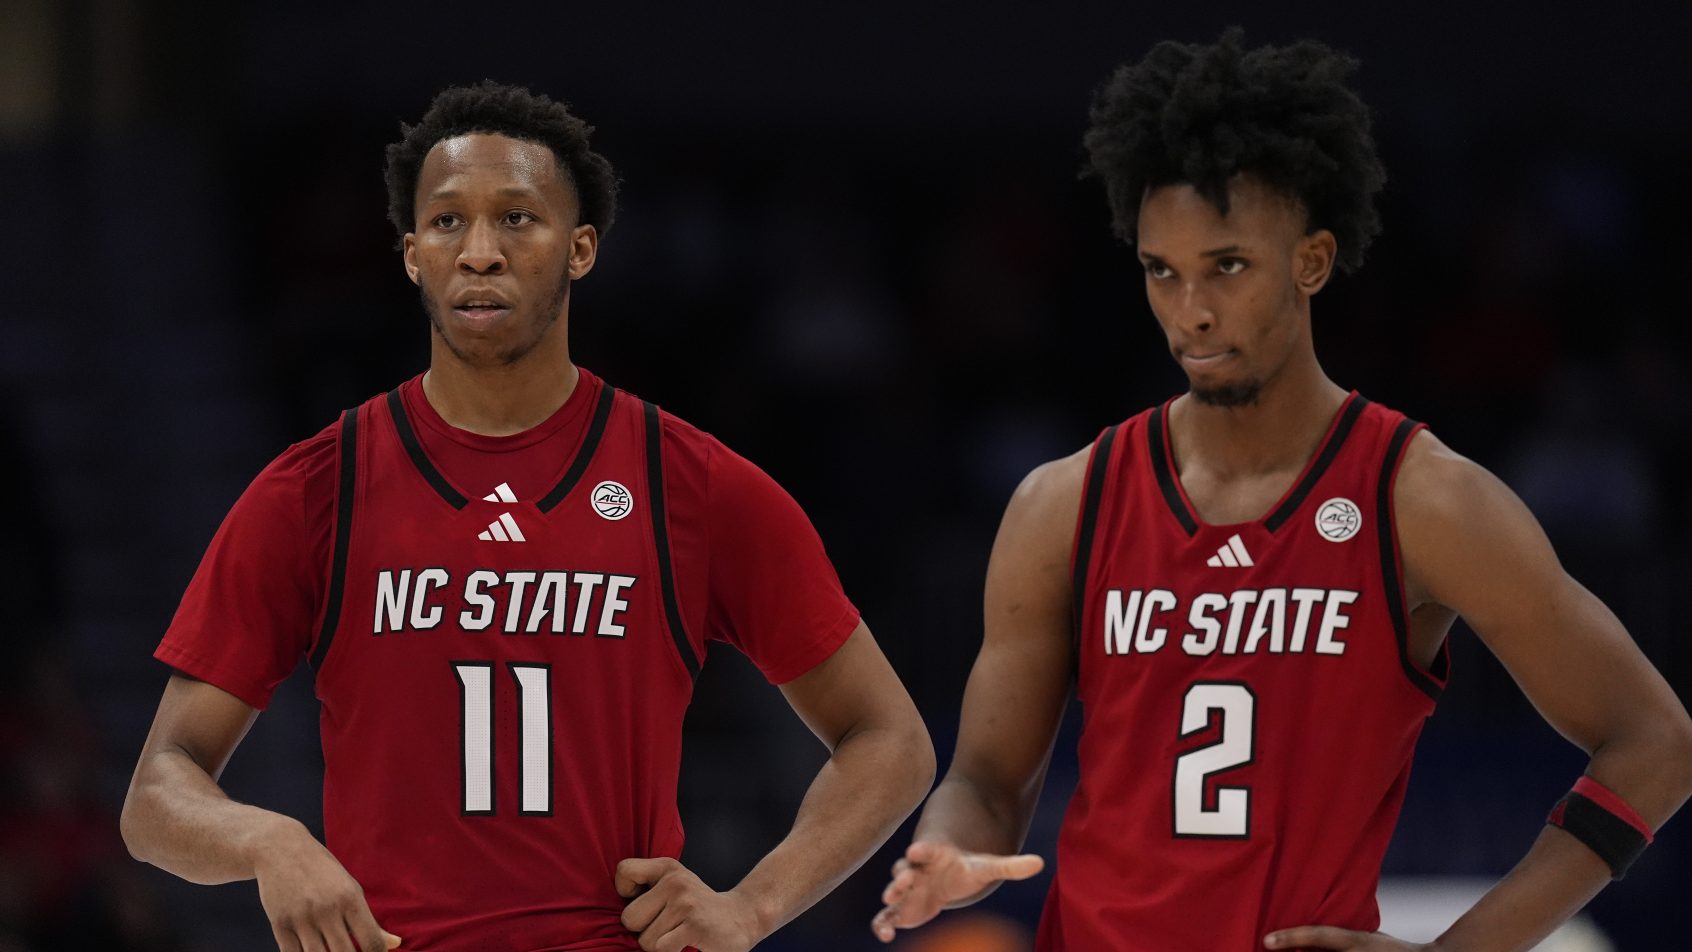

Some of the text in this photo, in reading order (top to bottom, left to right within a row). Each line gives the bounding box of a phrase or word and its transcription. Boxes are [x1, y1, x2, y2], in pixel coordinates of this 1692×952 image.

[598, 494, 628, 503] ACC
[1325, 513, 1355, 524] ACC
[373, 567, 638, 638] NC STATE
[1104, 587, 1360, 656] NC STATE
[451, 661, 553, 816] 11
[1172, 680, 1255, 839] 2
